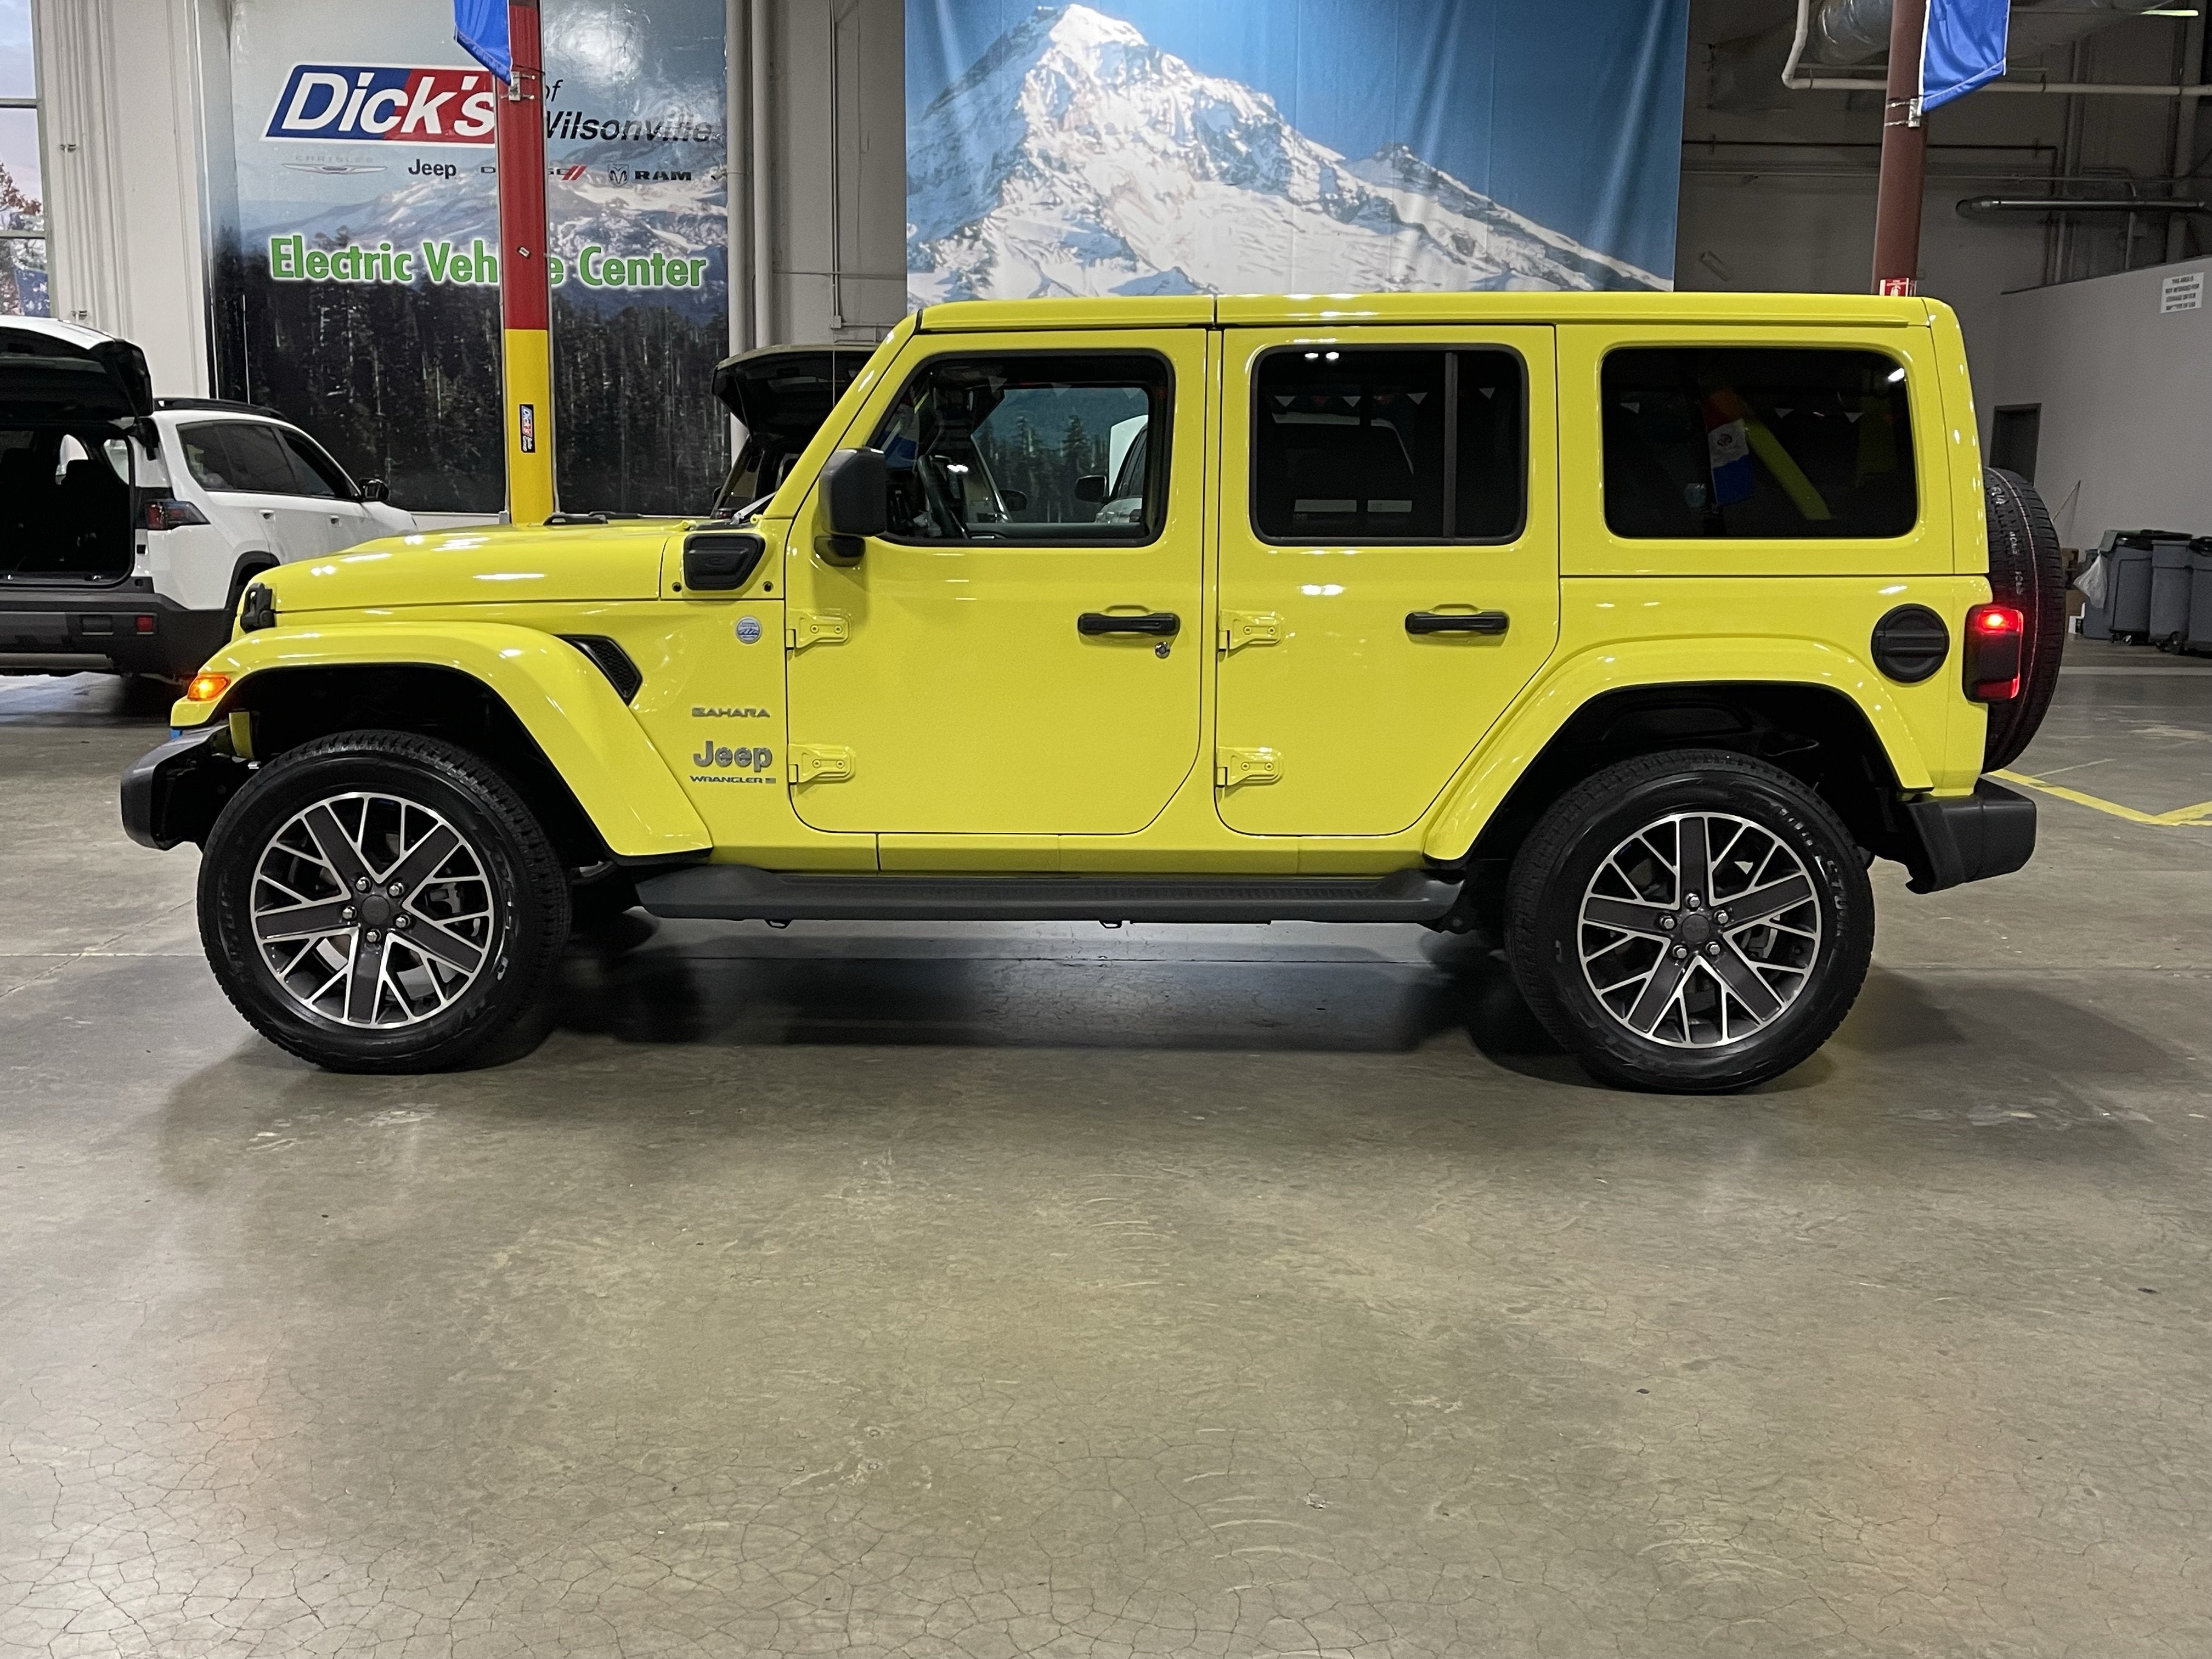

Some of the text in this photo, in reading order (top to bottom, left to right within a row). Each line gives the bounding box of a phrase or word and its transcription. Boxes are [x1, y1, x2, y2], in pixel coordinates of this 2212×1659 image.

[281, 72, 495, 136] Dick's
[408, 159, 456, 179] Jeep
[635, 171, 692, 180] RAM
[271, 235, 707, 286] Electric Vehe Center
[692, 707, 770, 718] SAHARA
[693, 741, 772, 772] Jeep
